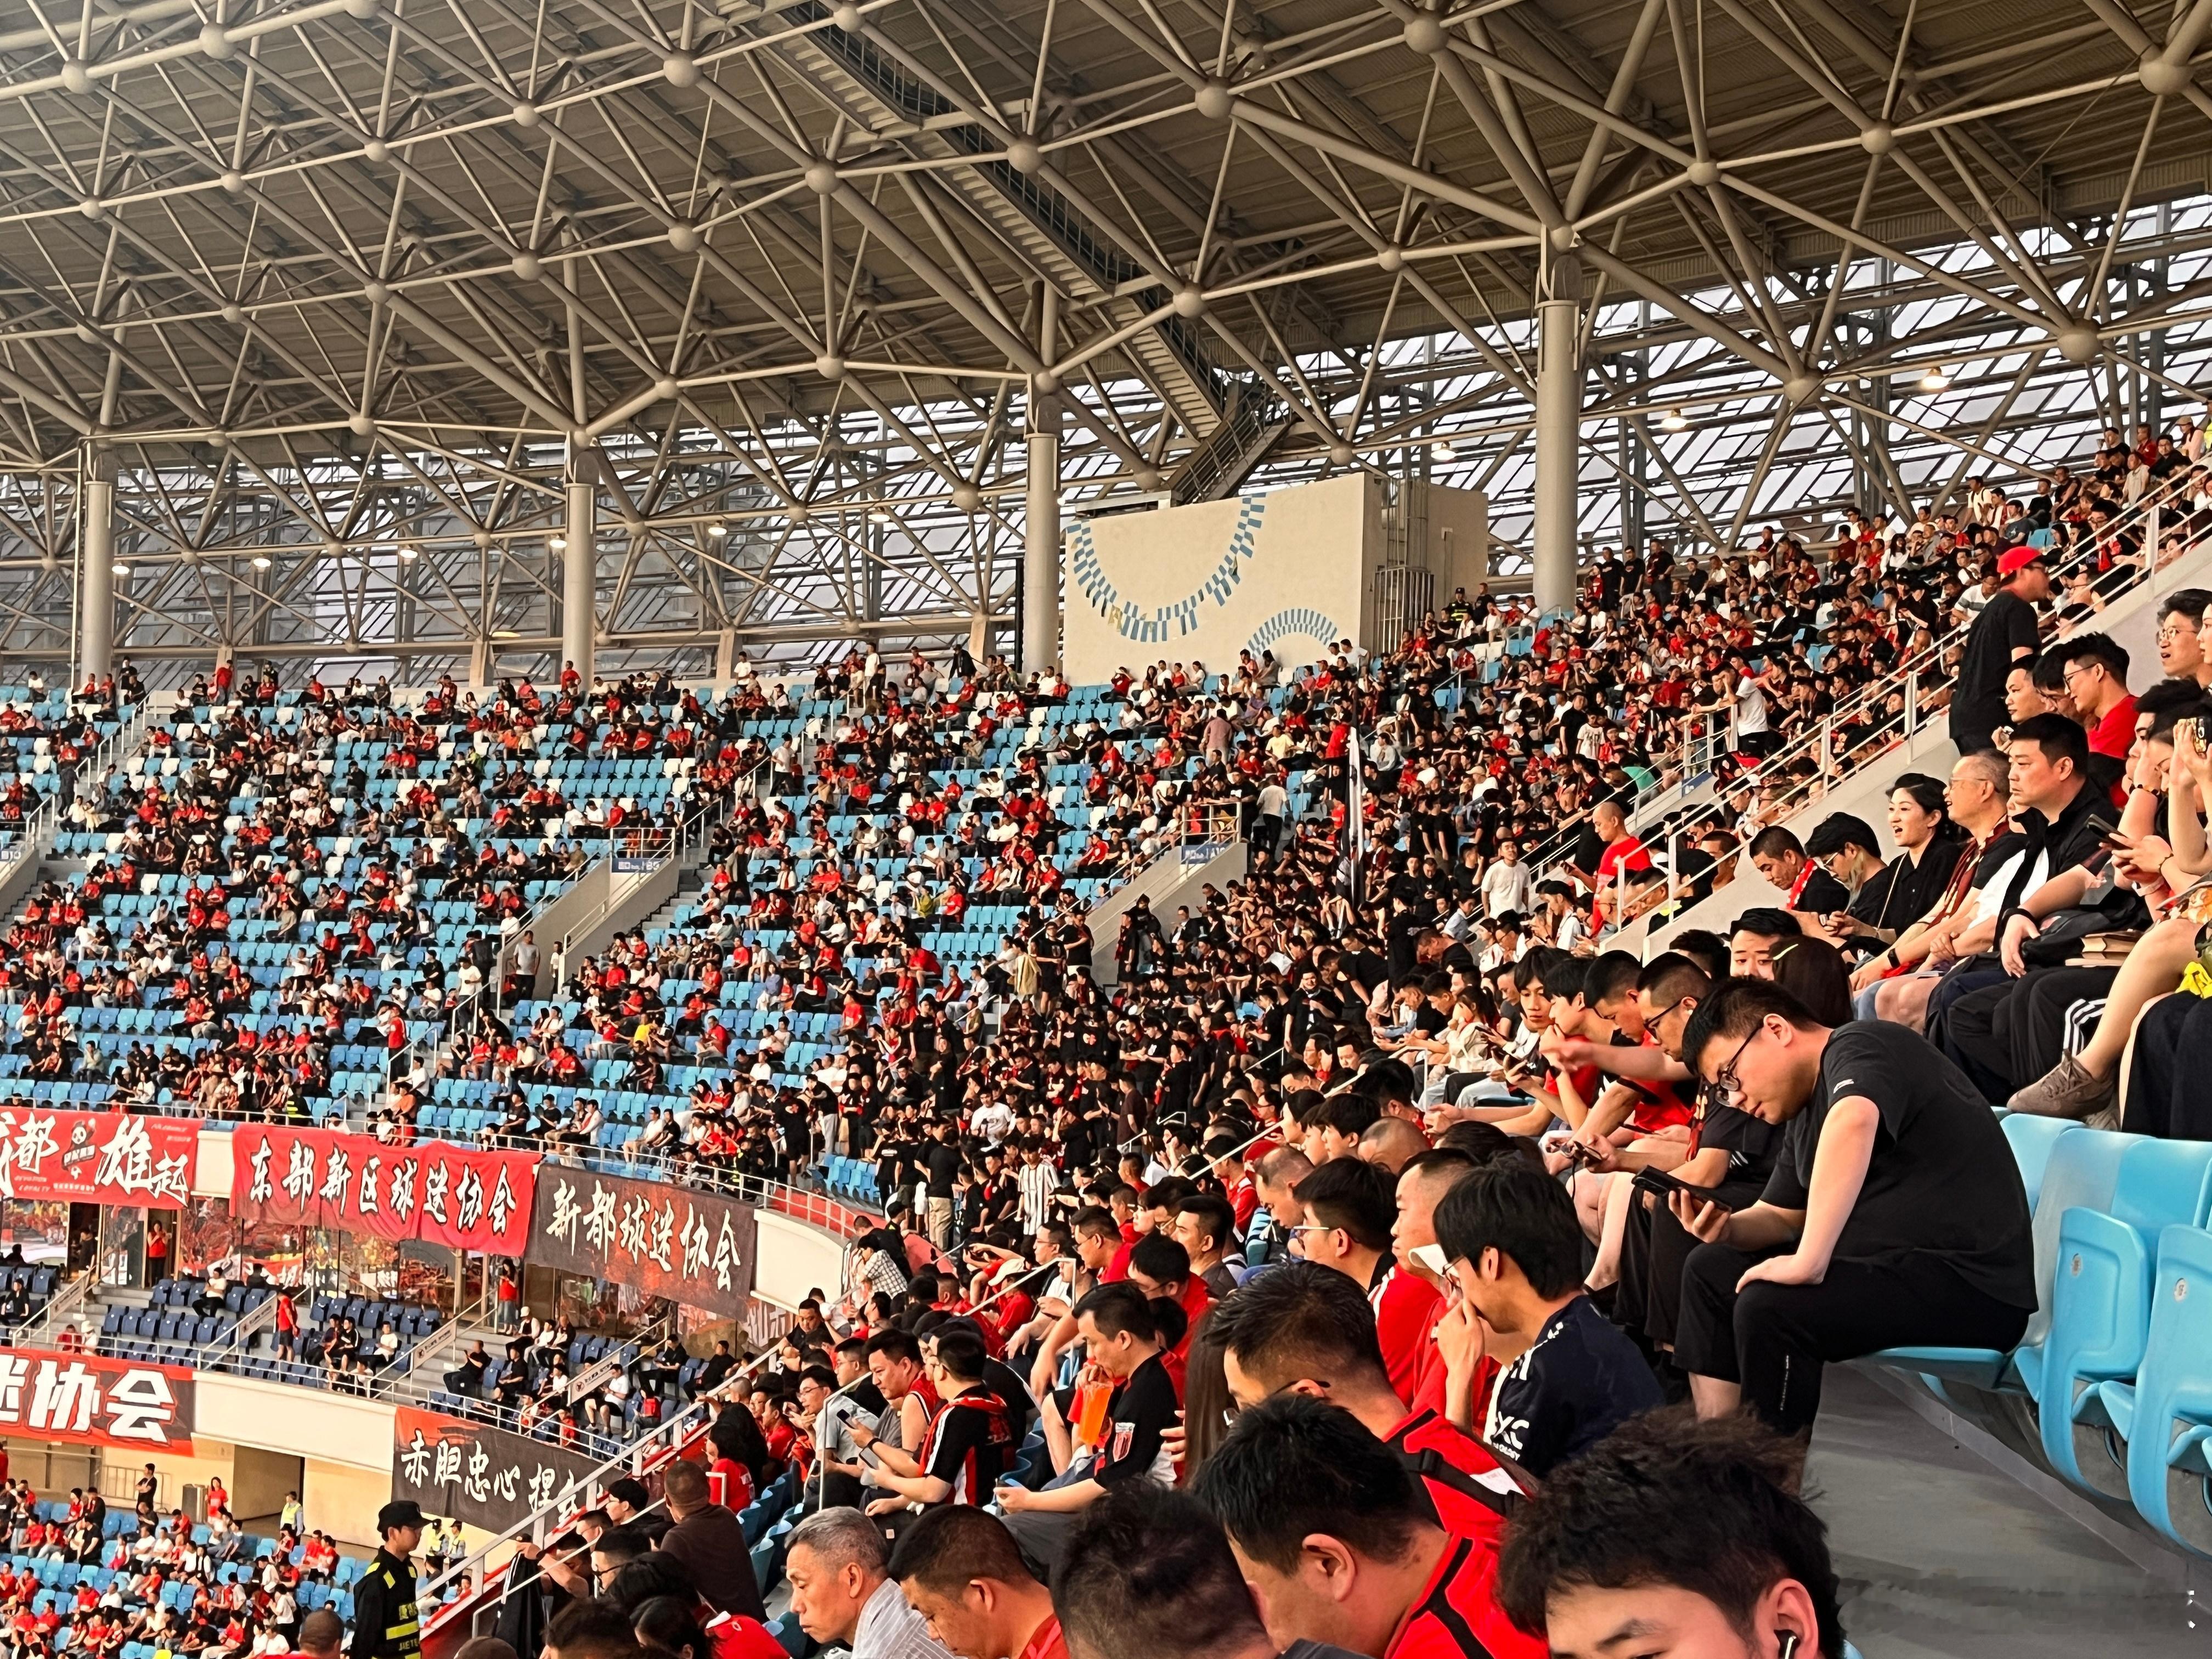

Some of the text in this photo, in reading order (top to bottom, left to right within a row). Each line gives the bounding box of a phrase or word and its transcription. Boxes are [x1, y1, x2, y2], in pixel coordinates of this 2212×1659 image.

[94, 1115, 189, 1207] 雄起
[249, 1135, 516, 1236] 东部新区球迷协会
[546, 1178, 741, 1292] 新都球迷协会
